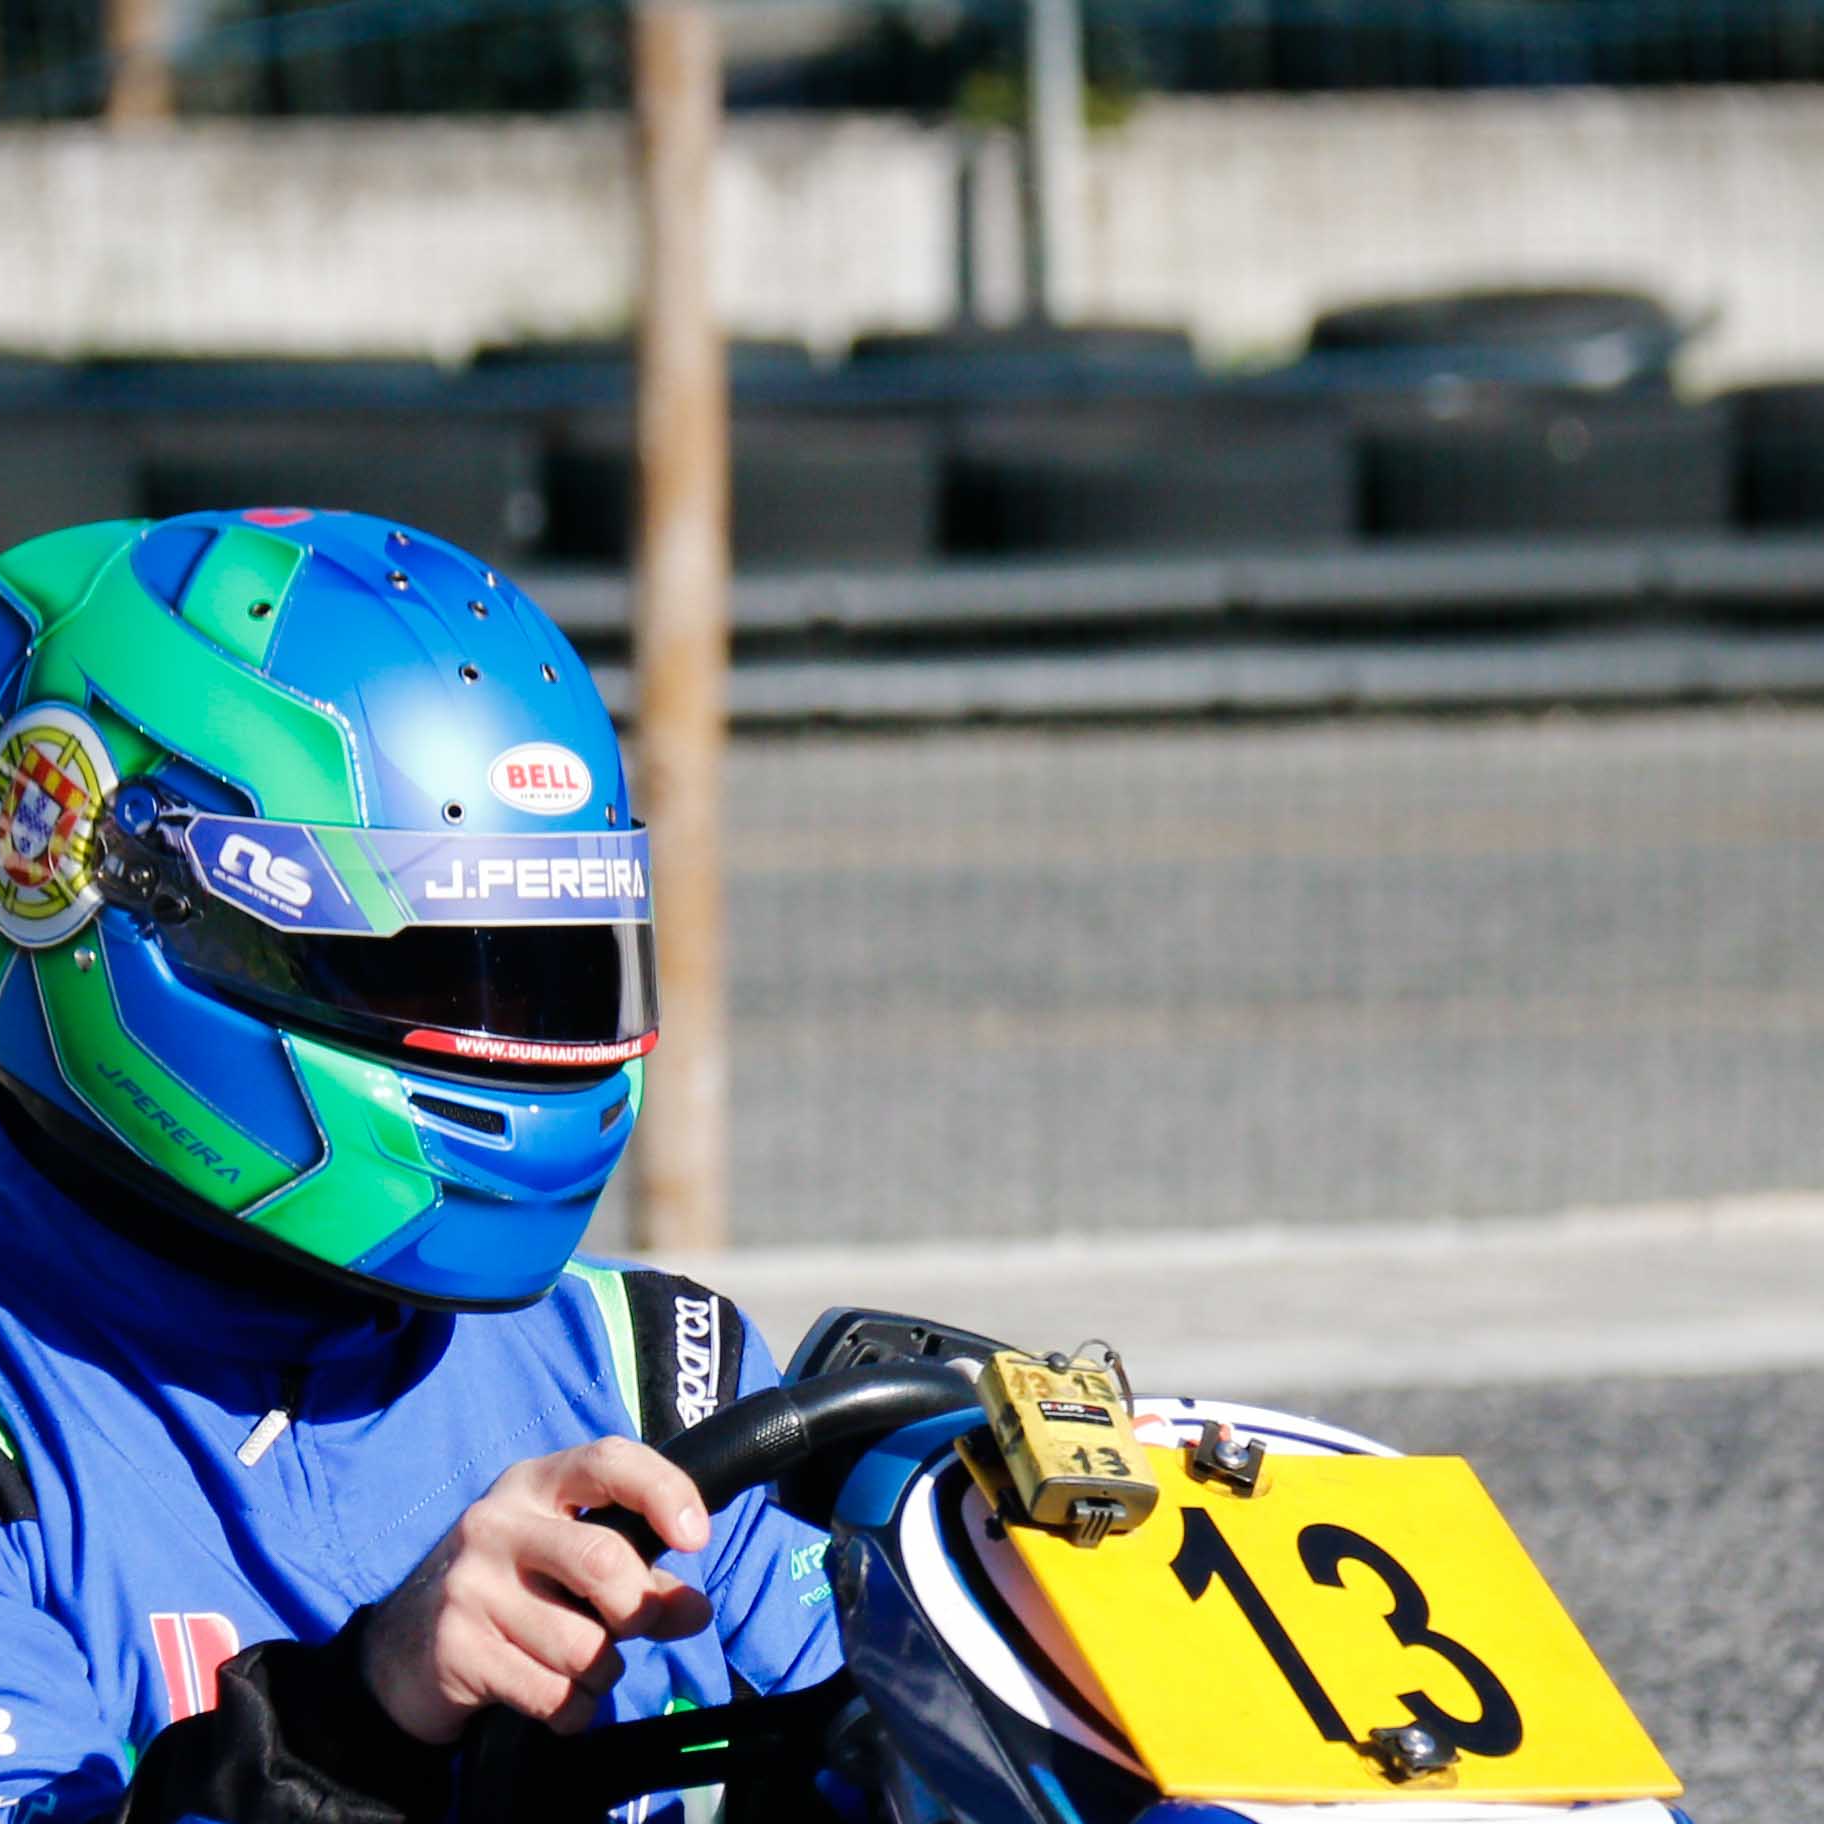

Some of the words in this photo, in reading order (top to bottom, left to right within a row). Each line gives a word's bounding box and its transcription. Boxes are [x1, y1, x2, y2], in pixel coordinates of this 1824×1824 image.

[507, 764, 579, 789] BELL
[1072, 1446, 1131, 1475] 13
[1170, 1507, 1523, 1757] 13
